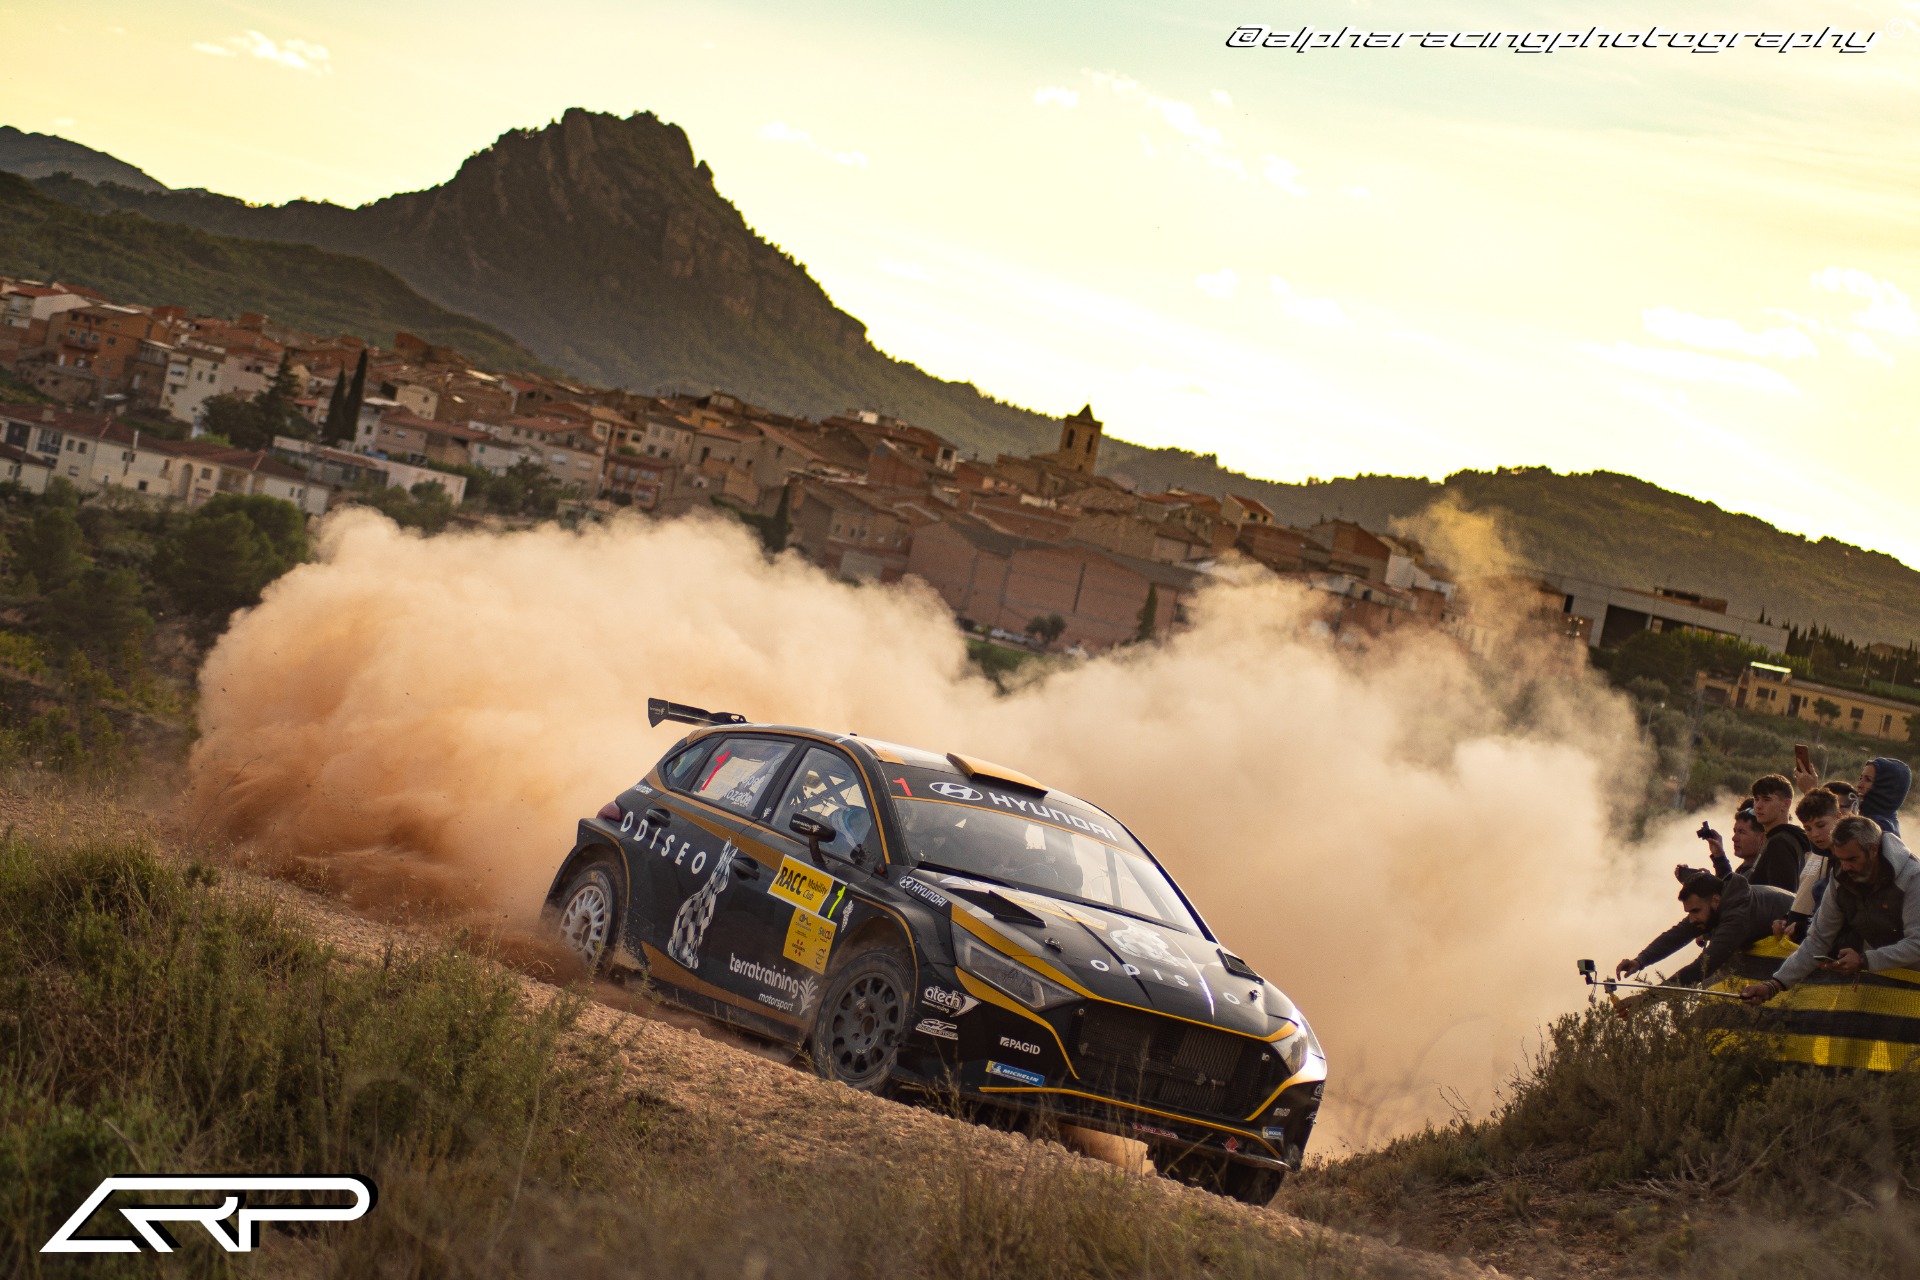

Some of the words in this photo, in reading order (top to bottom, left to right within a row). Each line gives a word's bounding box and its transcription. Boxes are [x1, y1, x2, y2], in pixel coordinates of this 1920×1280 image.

[701, 749, 731, 791] 1
[892, 777, 914, 797] 1
[988, 791, 1119, 842] HYUNDAI
[620, 811, 707, 875] ODISEO
[775, 866, 808, 896] RACC
[807, 878, 828, 897] Mobility
[802, 889, 815, 901] Club
[911, 882, 948, 908] HYUNDAI
[827, 885, 846, 919] 1
[729, 952, 799, 999] terratraining
[1090, 959, 1241, 1005] ODISO
[758, 993, 794, 1012] motorsport
[924, 986, 961, 1010] atech
[1009, 1038, 1041, 1055] PAGID
[1002, 1068, 1040, 1083] MICHELIN
